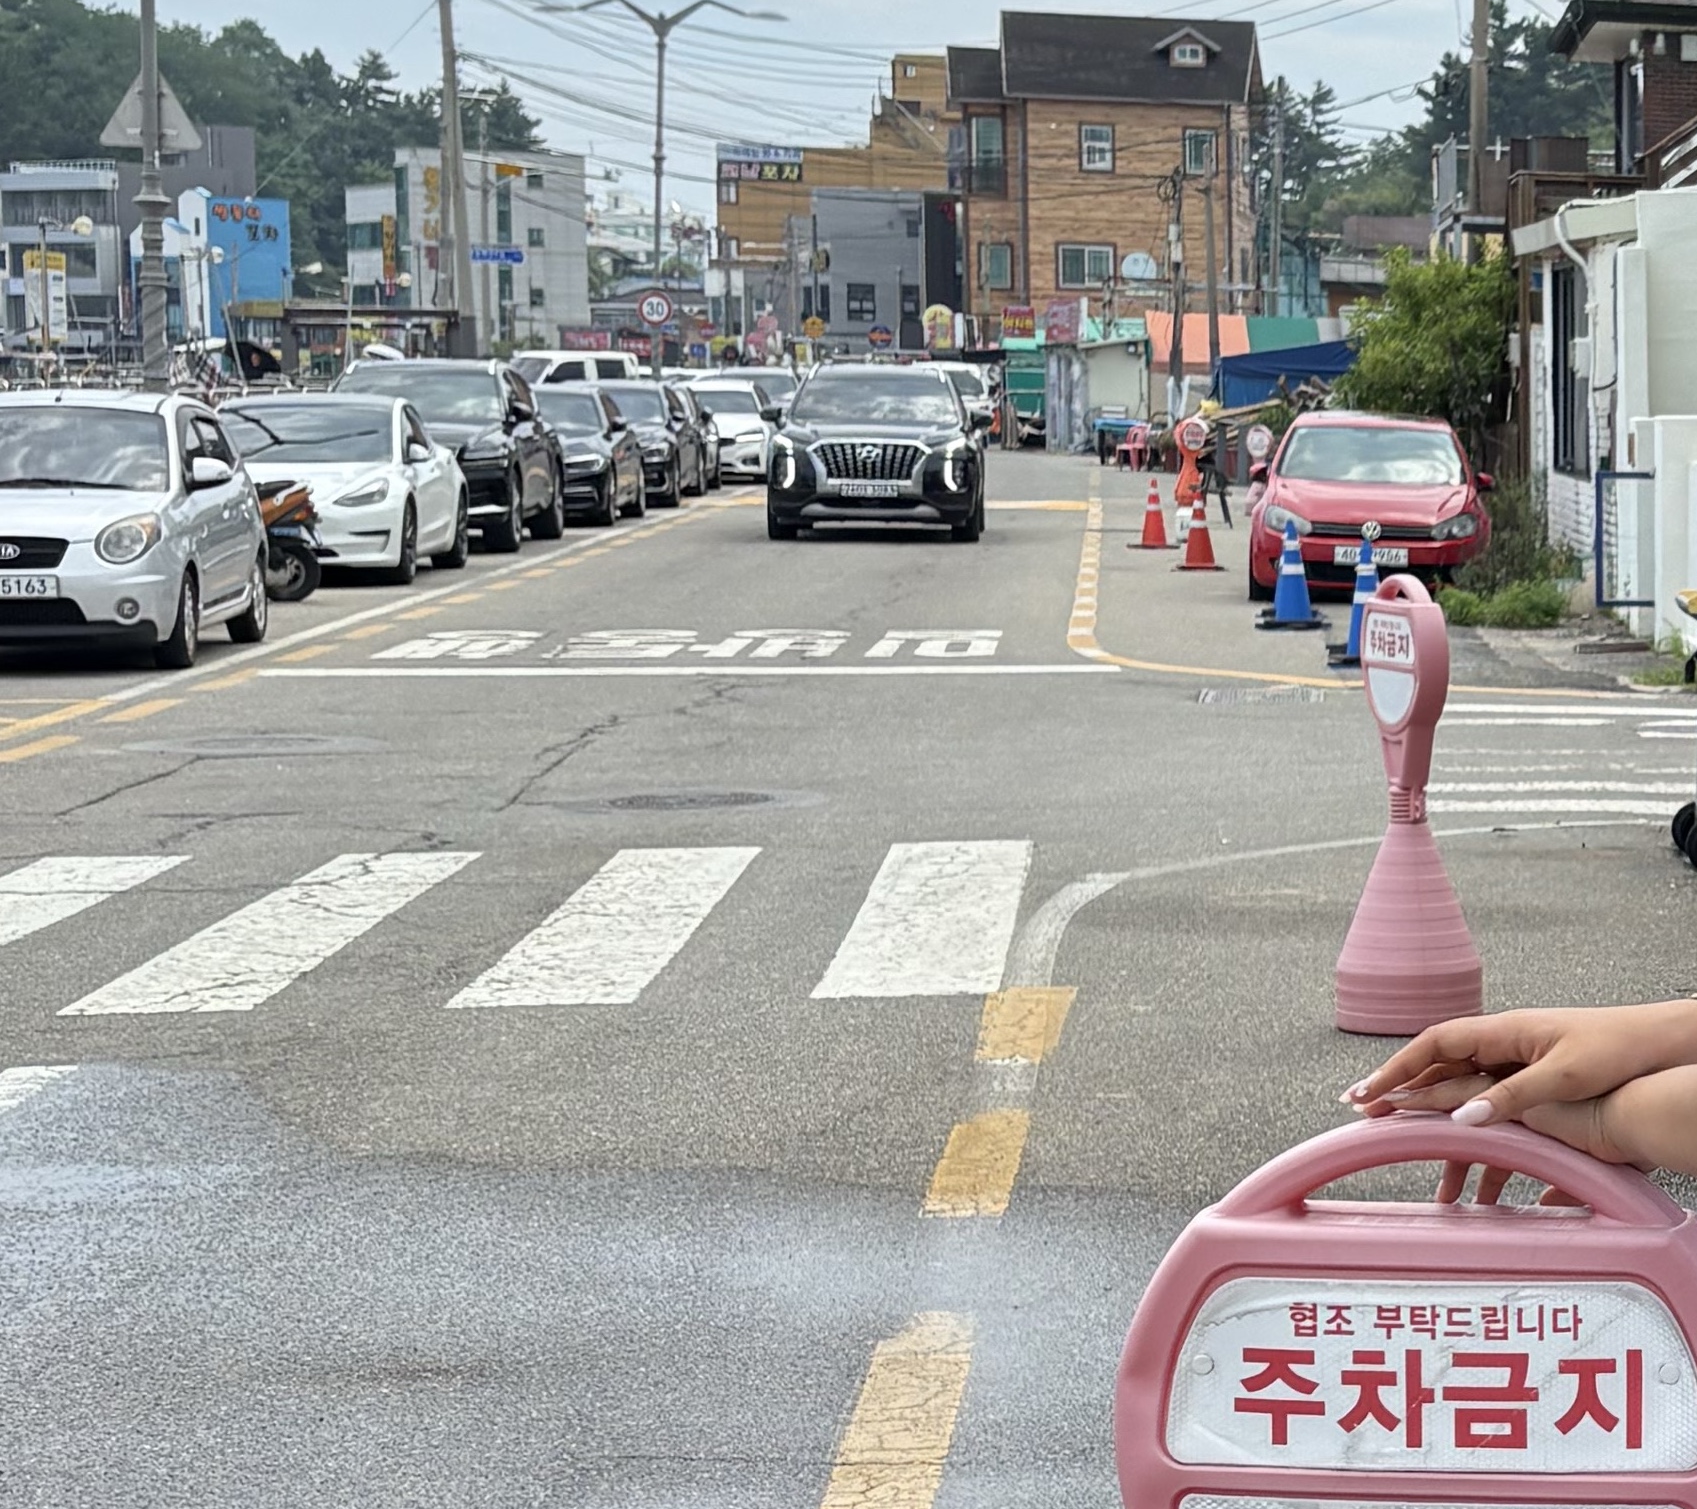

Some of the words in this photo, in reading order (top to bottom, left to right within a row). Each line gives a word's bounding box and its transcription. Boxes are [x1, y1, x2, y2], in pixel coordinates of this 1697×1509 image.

[646, 300, 665, 317] 30
[1, 578, 47, 595] 5163
[1370, 629, 1410, 660] 주차금지
[1288, 1301, 1355, 1338] 협조
[1373, 1302, 1583, 1341] 부탁드립니다
[1233, 1347, 1644, 1451] 주차금지
